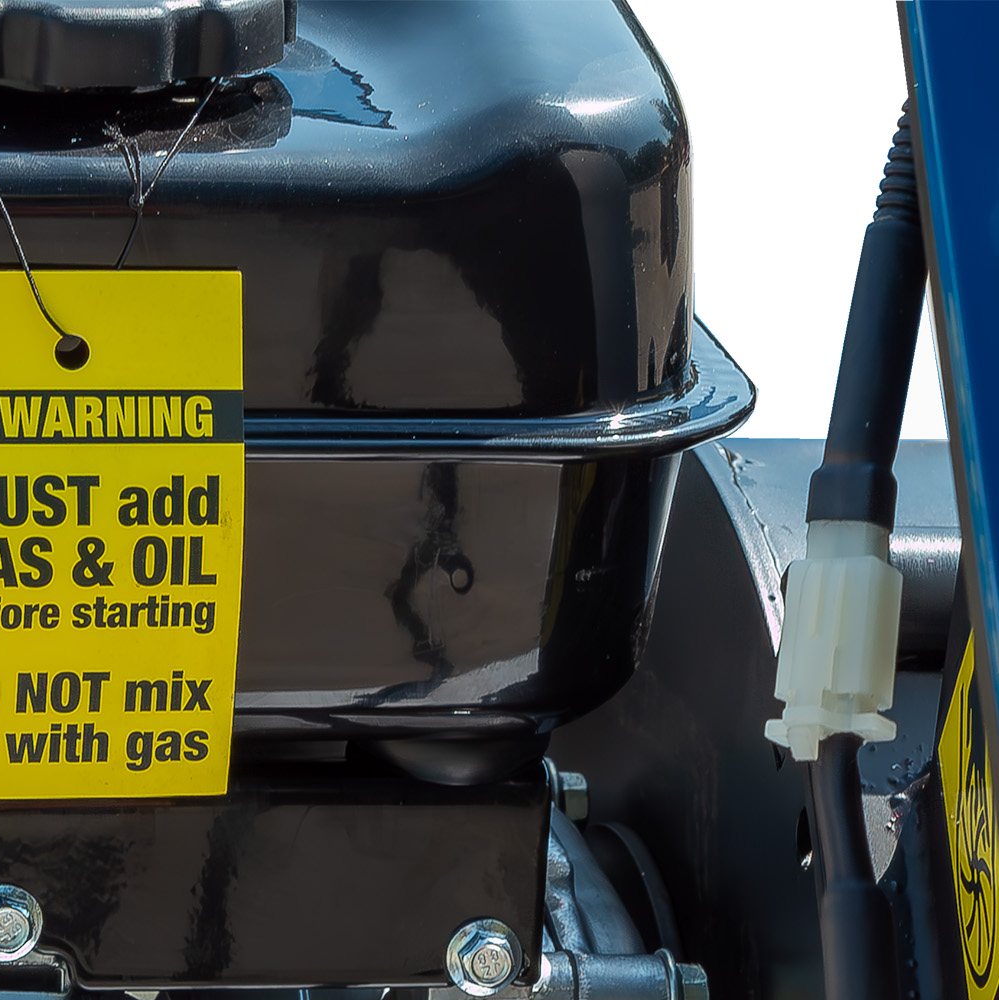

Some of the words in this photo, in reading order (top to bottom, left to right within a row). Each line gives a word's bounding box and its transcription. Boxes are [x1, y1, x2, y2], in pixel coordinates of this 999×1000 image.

[118, 475, 220, 527] add
[71, 536, 114, 588] &
[132, 535, 217, 587] OIL
[72, 595, 216, 634] starting
[15, 671, 110, 714] NOT
[124, 670, 213, 713] mix
[5, 723, 109, 764] with
[125, 728, 209, 771] gas
